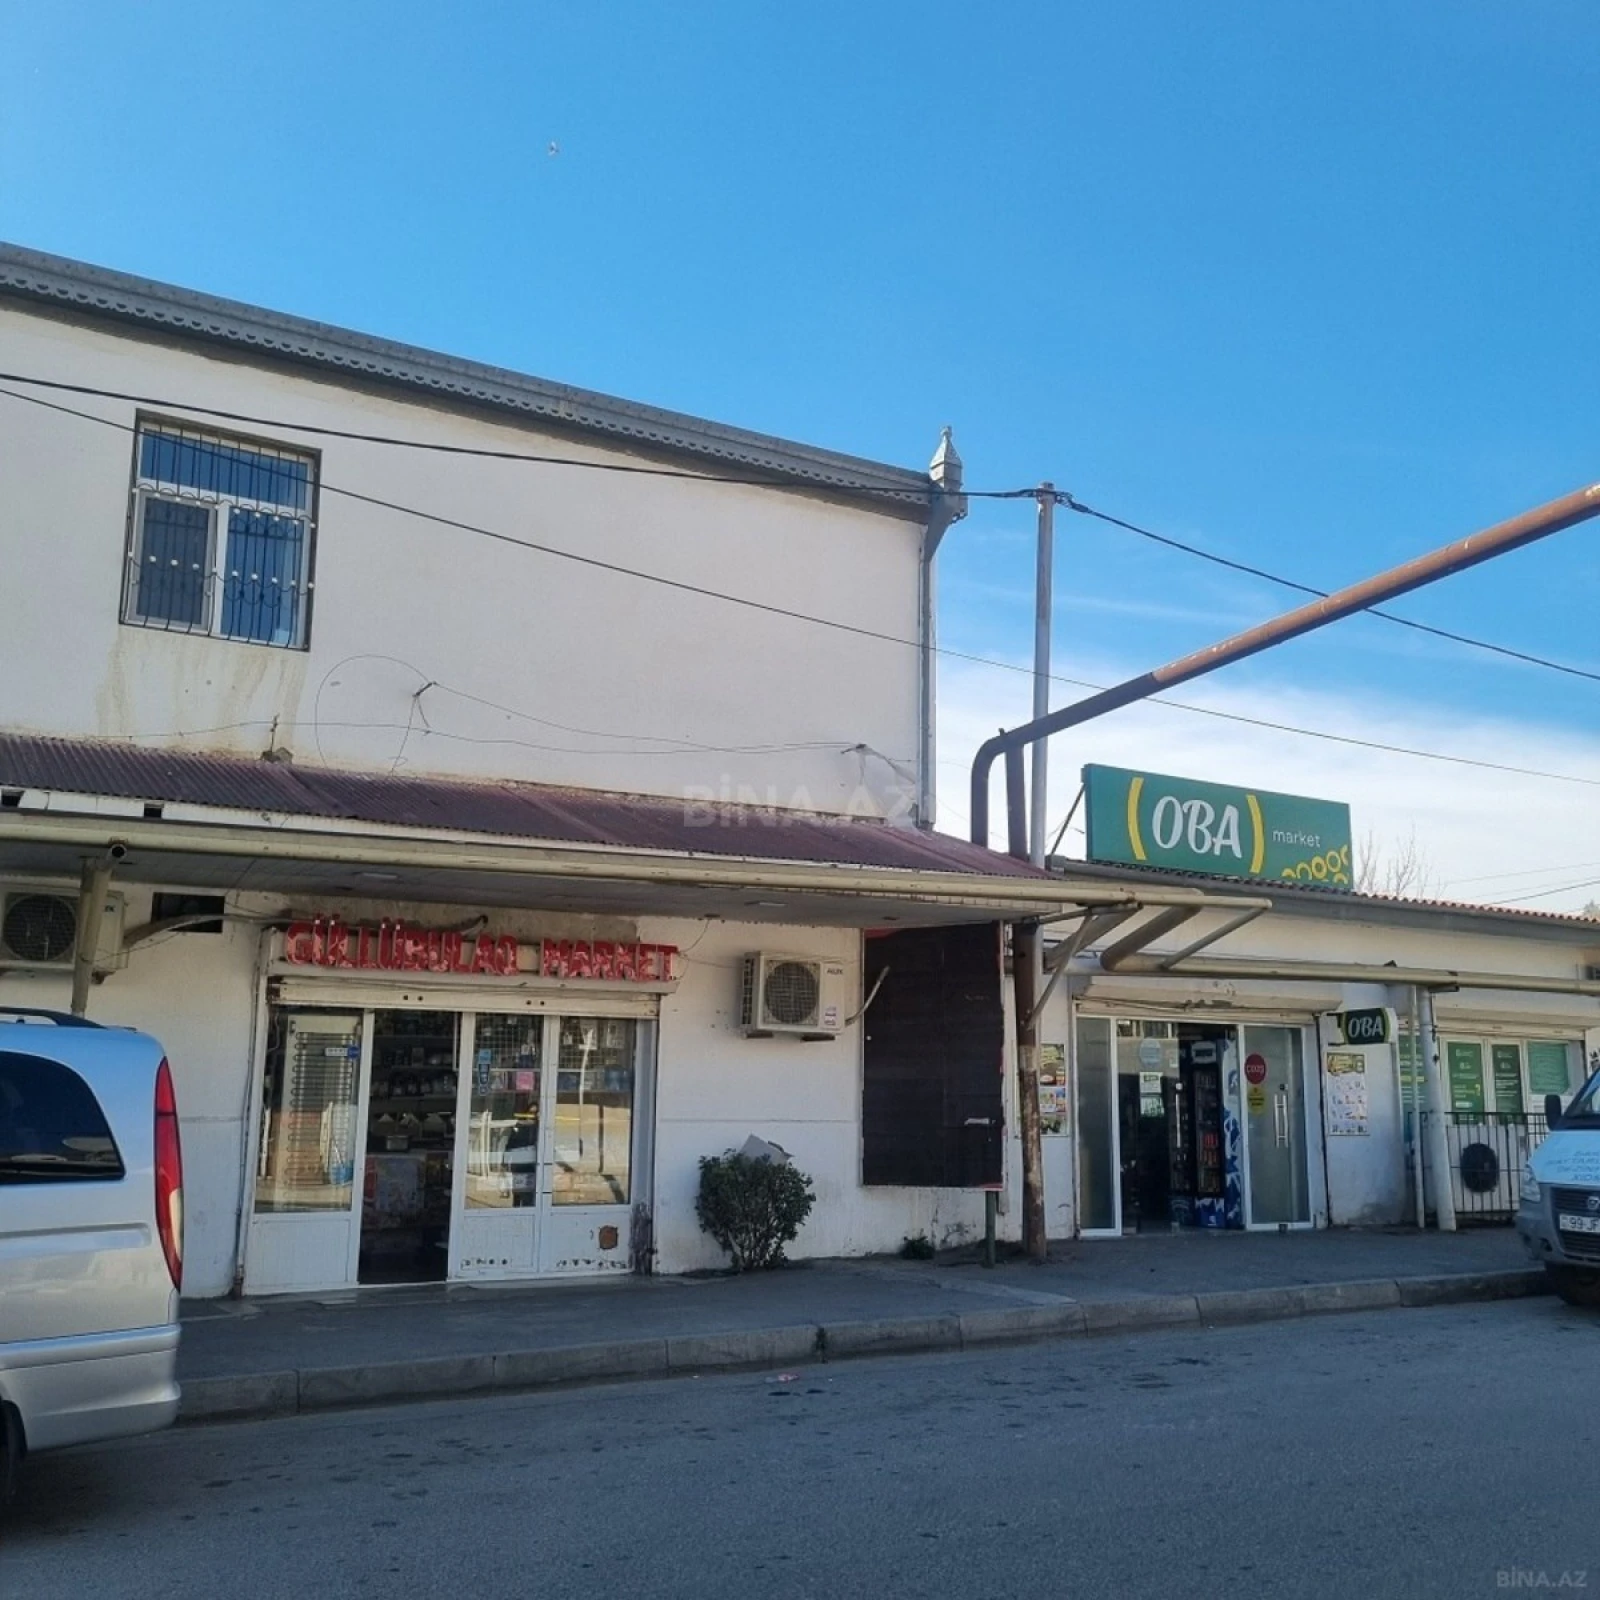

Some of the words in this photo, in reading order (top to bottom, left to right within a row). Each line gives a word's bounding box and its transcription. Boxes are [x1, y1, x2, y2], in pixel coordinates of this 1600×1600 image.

[1272, 828, 1321, 848] market
[540, 937, 680, 982] MARKET
[1347, 1016, 1384, 1038] OBA
